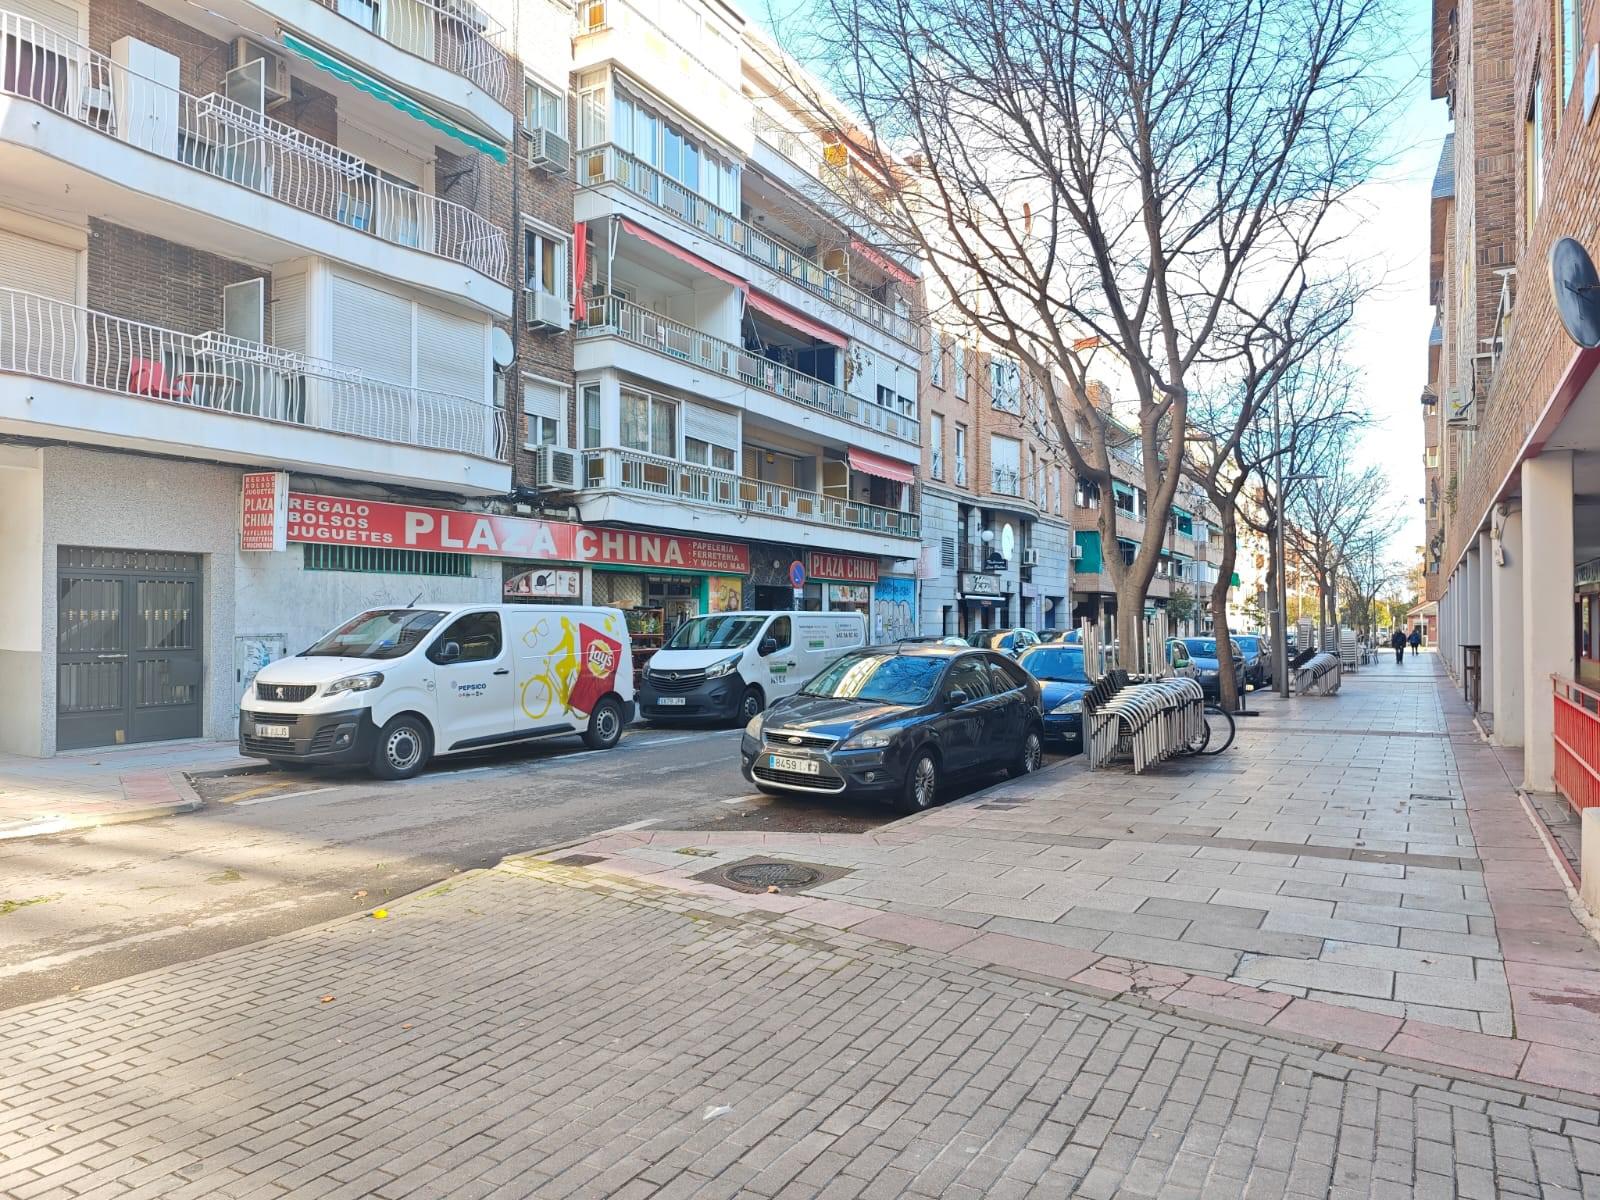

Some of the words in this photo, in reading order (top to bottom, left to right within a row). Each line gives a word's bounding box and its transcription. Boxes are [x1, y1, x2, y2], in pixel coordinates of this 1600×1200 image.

[245, 497, 274, 512] PLAZA
[288, 497, 370, 516] REGALO
[244, 513, 274, 527] CHINA
[287, 511, 369, 529] BOLSOS
[287, 526, 393, 543] JUGUETES
[404, 511, 558, 555] PLAZA
[574, 529, 684, 565] CHINA
[692, 541, 734, 553] PAPELERIA
[692, 550, 740, 562] FERRETERIA
[701, 559, 728, 569] MUCHO
[813, 554, 845, 577] PLAZA
[847, 558, 876, 580] CHINA
[458, 683, 487, 691] PEPSICO
